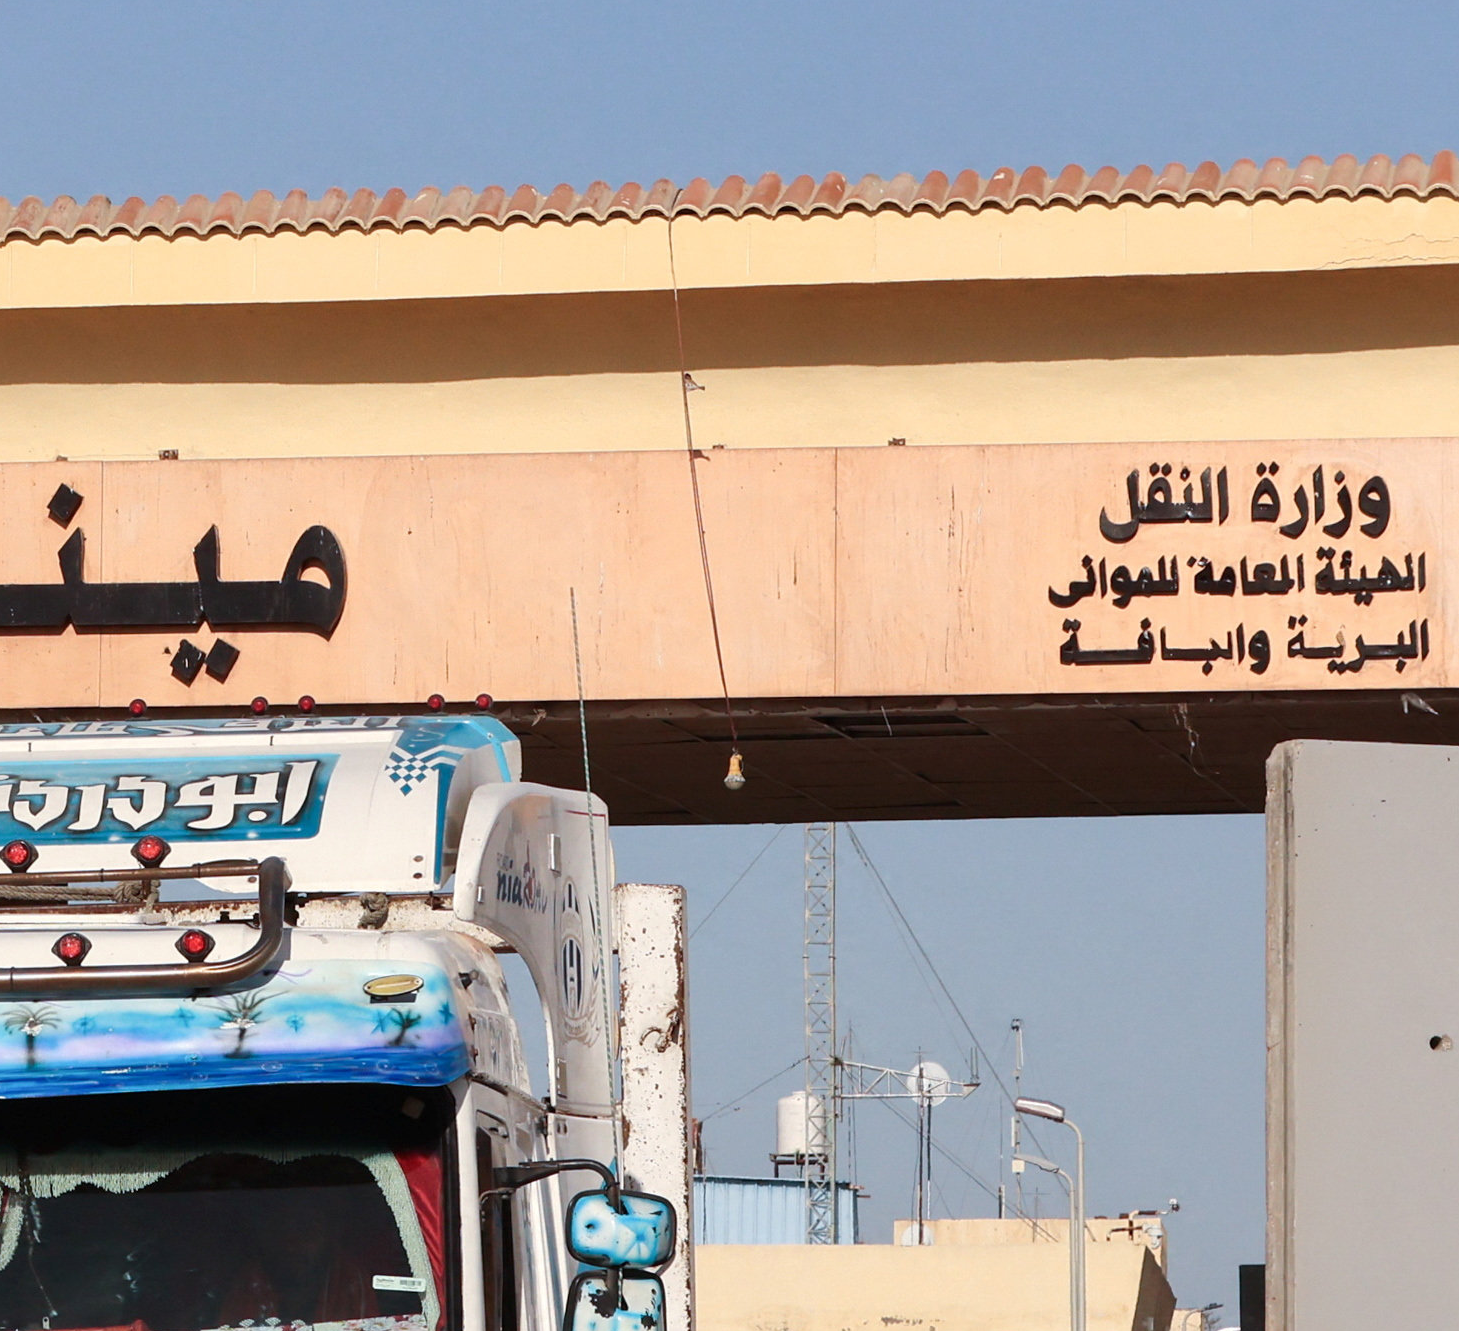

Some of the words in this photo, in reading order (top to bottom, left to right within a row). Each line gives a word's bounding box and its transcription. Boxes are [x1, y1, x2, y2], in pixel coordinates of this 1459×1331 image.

[1100, 463, 1229, 543] النقل
[1252, 462, 1391, 539] وزارة
[1187, 554, 1305, 597] العامة
[1315, 547, 1426, 606] الهيئة
[1060, 618, 1271, 675] والجافة
[1288, 616, 1429, 675] البرية
